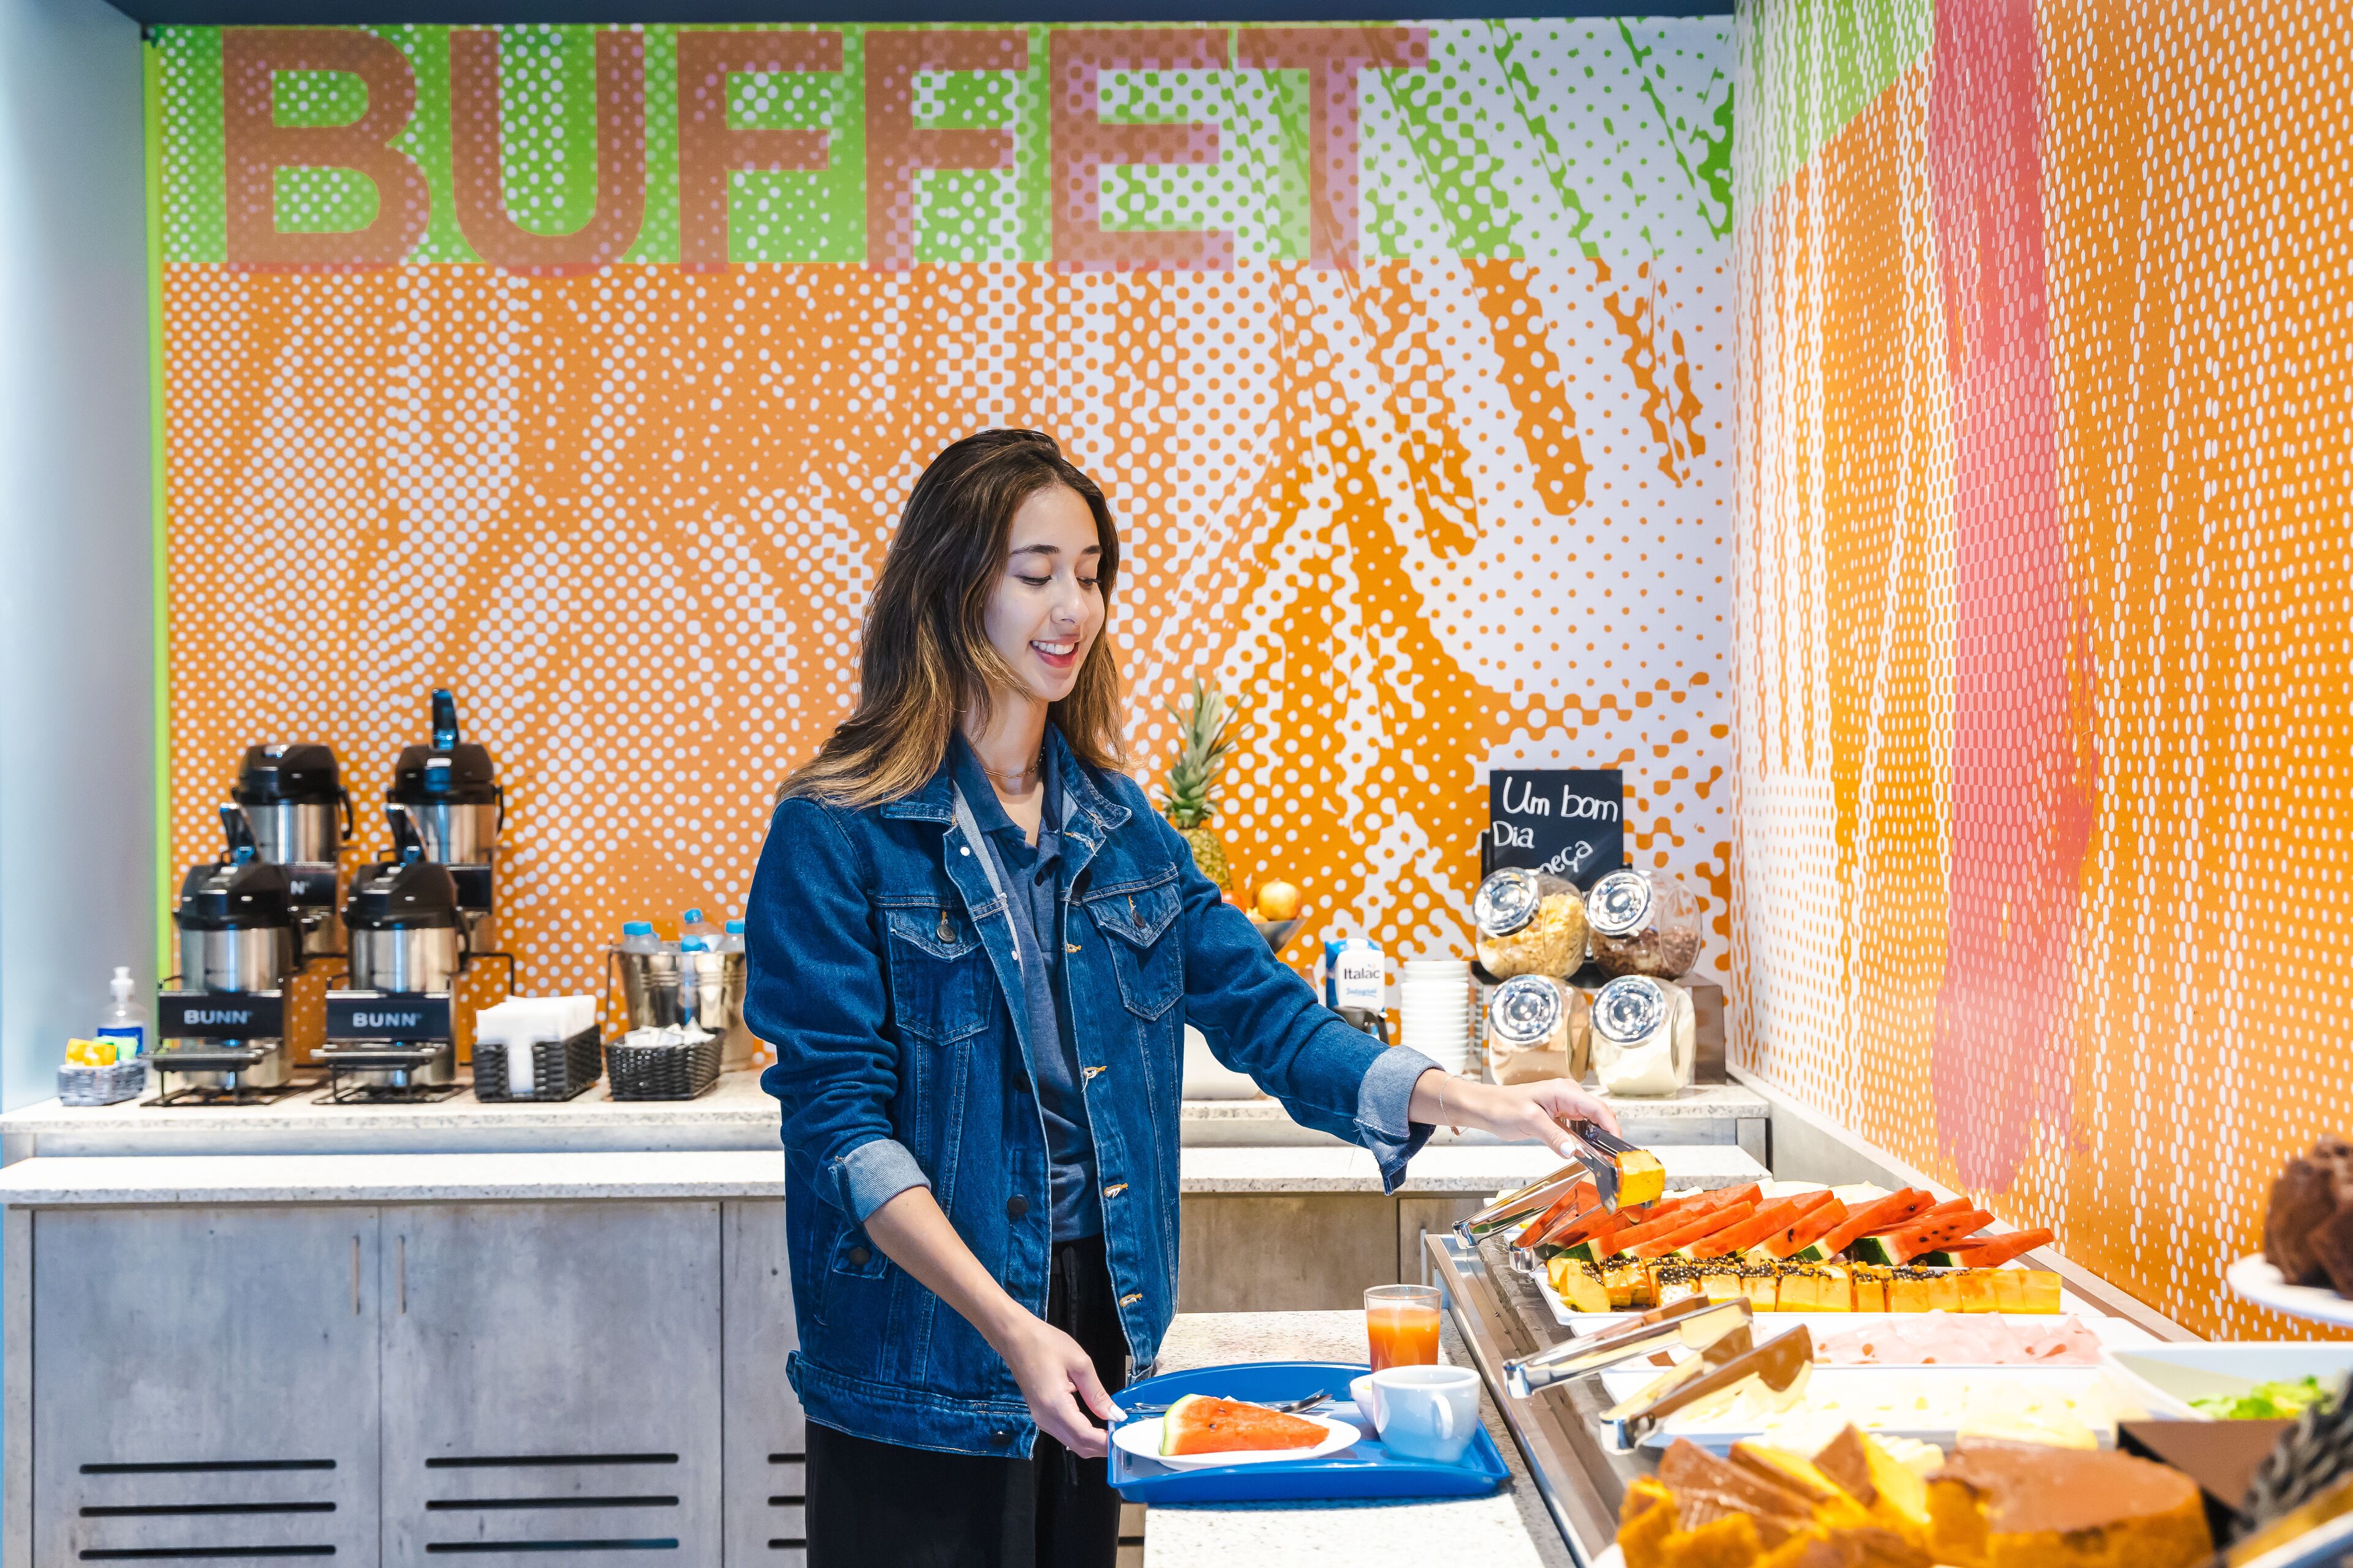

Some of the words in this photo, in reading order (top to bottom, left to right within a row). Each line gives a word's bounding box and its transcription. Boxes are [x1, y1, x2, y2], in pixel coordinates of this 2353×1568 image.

[222, 28, 1429, 278] BUFFET
[1502, 776, 1550, 817] Um
[1560, 784, 1618, 823] bom
[1492, 820, 1536, 849] Dia
[1344, 968, 1381, 980] Italac
[184, 1009, 249, 1025] BUNN
[352, 1012, 417, 1028] BUNN
